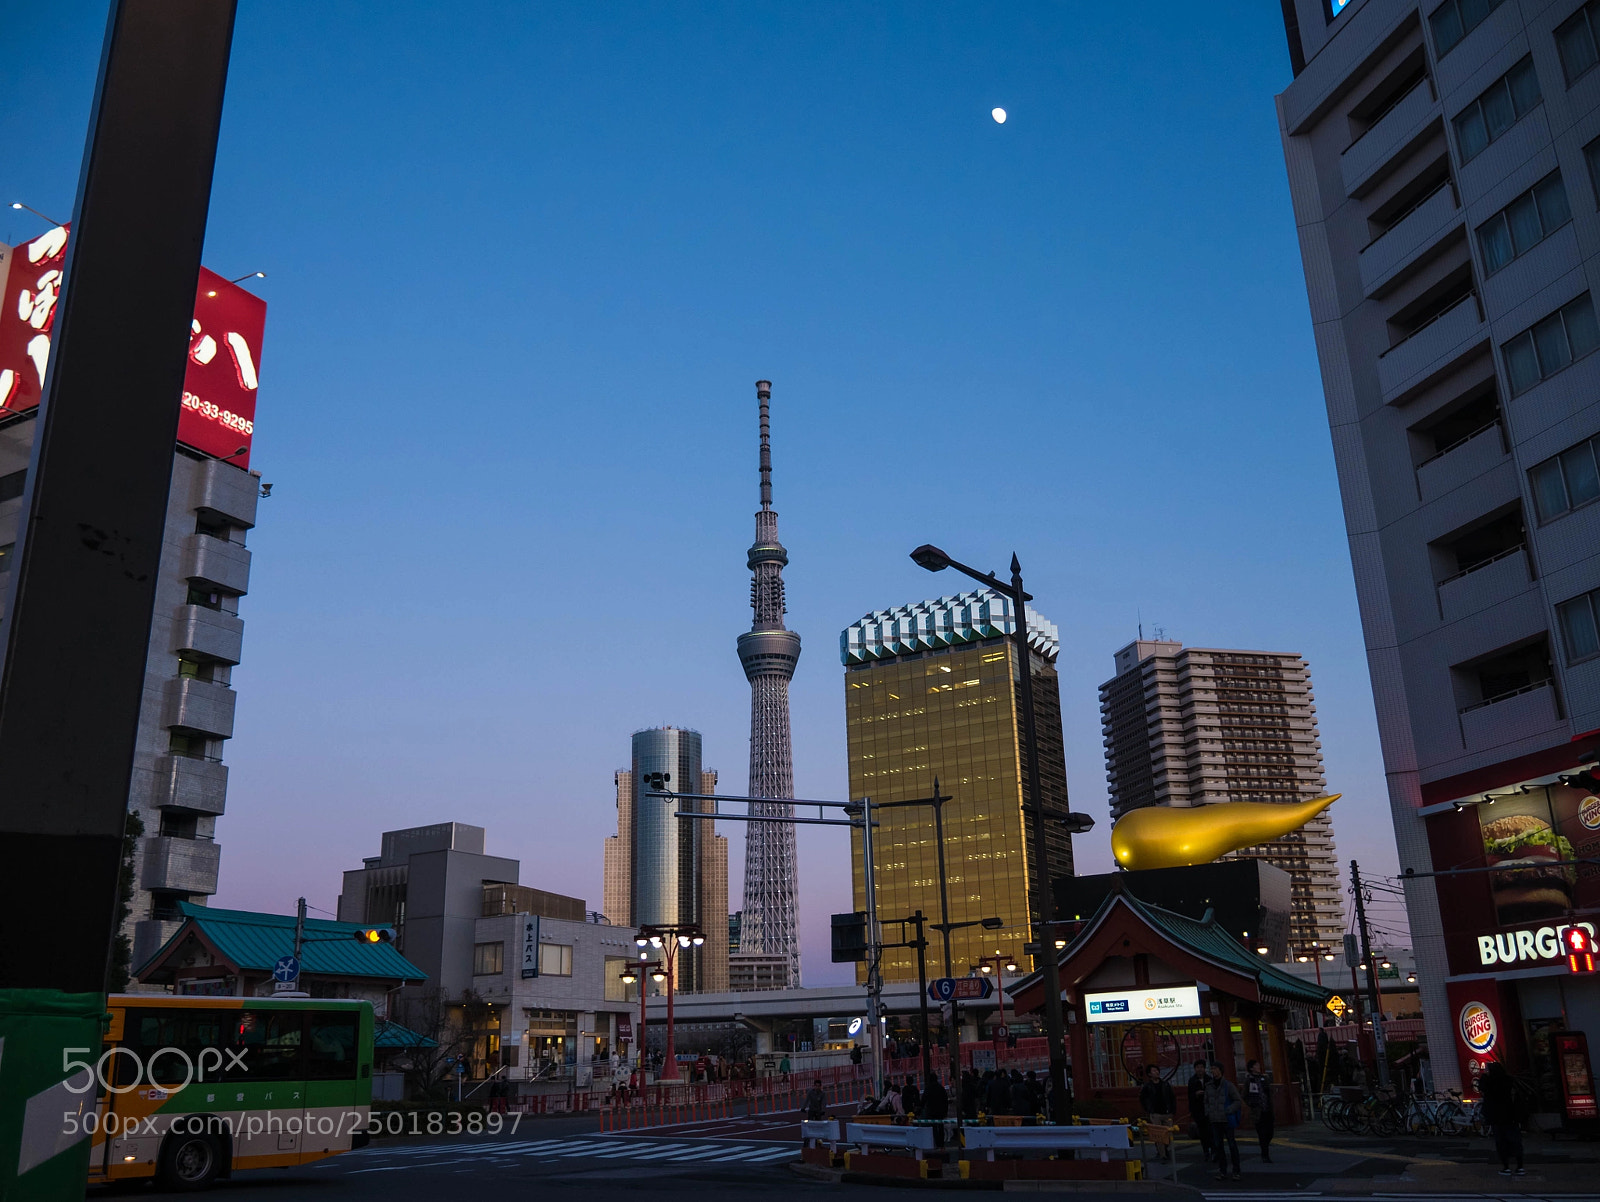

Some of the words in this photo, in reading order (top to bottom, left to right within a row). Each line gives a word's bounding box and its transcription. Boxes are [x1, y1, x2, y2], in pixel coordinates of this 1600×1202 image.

[182, 391, 254, 435] 20-33-9295
[525, 922, 533, 963] 水上バス
[941, 980, 950, 995] 6
[1464, 1011, 1489, 1030] BURGER
[1466, 1019, 1491, 1041] KING
